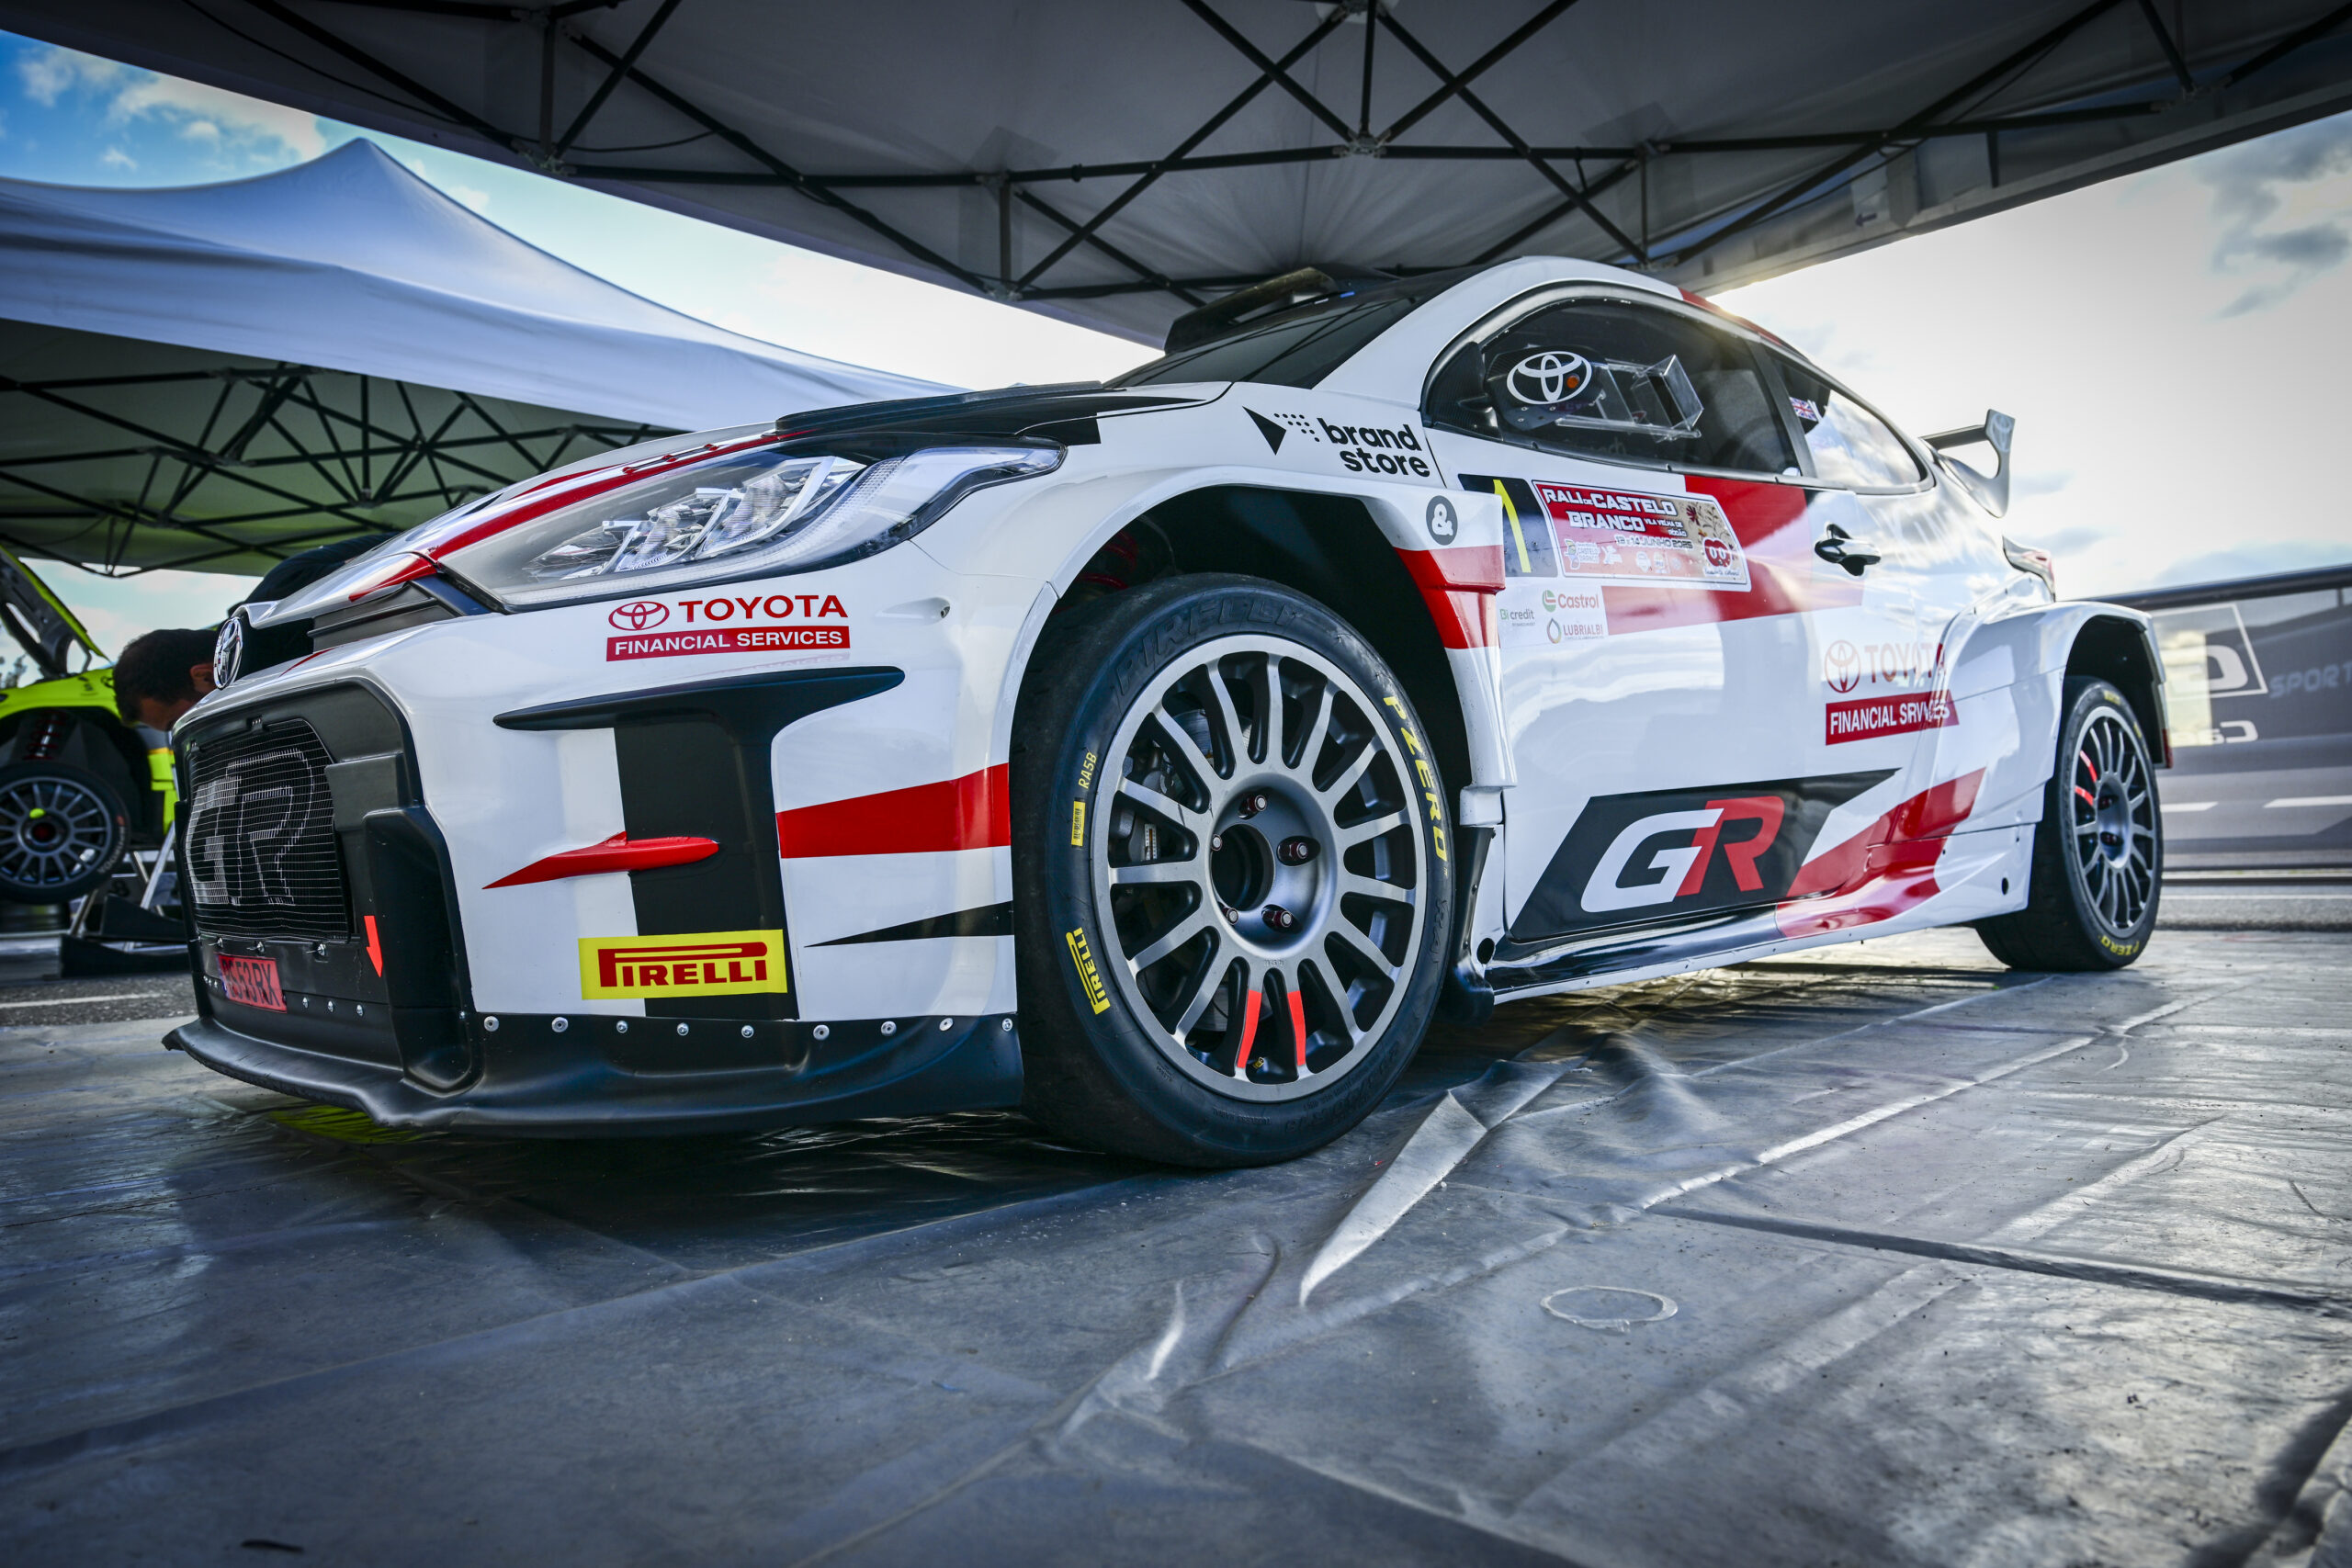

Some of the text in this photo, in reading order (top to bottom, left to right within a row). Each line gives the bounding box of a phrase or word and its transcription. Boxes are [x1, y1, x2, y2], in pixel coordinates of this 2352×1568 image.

[1317, 417, 1421, 451] brand
[1340, 447, 1430, 477] store
[1542, 488, 1584, 504] RALI
[1590, 492, 1679, 516] CASTELO
[1566, 511, 1646, 532] BRANCO
[678, 595, 848, 623] TOYOTA
[1510, 608, 1535, 620] credit
[1558, 593, 1600, 609] Castrol
[615, 630, 842, 656] FINANCIAL SERVICES
[1564, 624, 1603, 636] LUBRIALBI
[1830, 705, 1897, 735] FINANCIAL
[1079, 751, 1097, 789] RA5B
[1581, 795, 1784, 913] GR
[598, 942, 767, 987] PIRELLI
[1066, 927, 1111, 1015] PIRELLI
